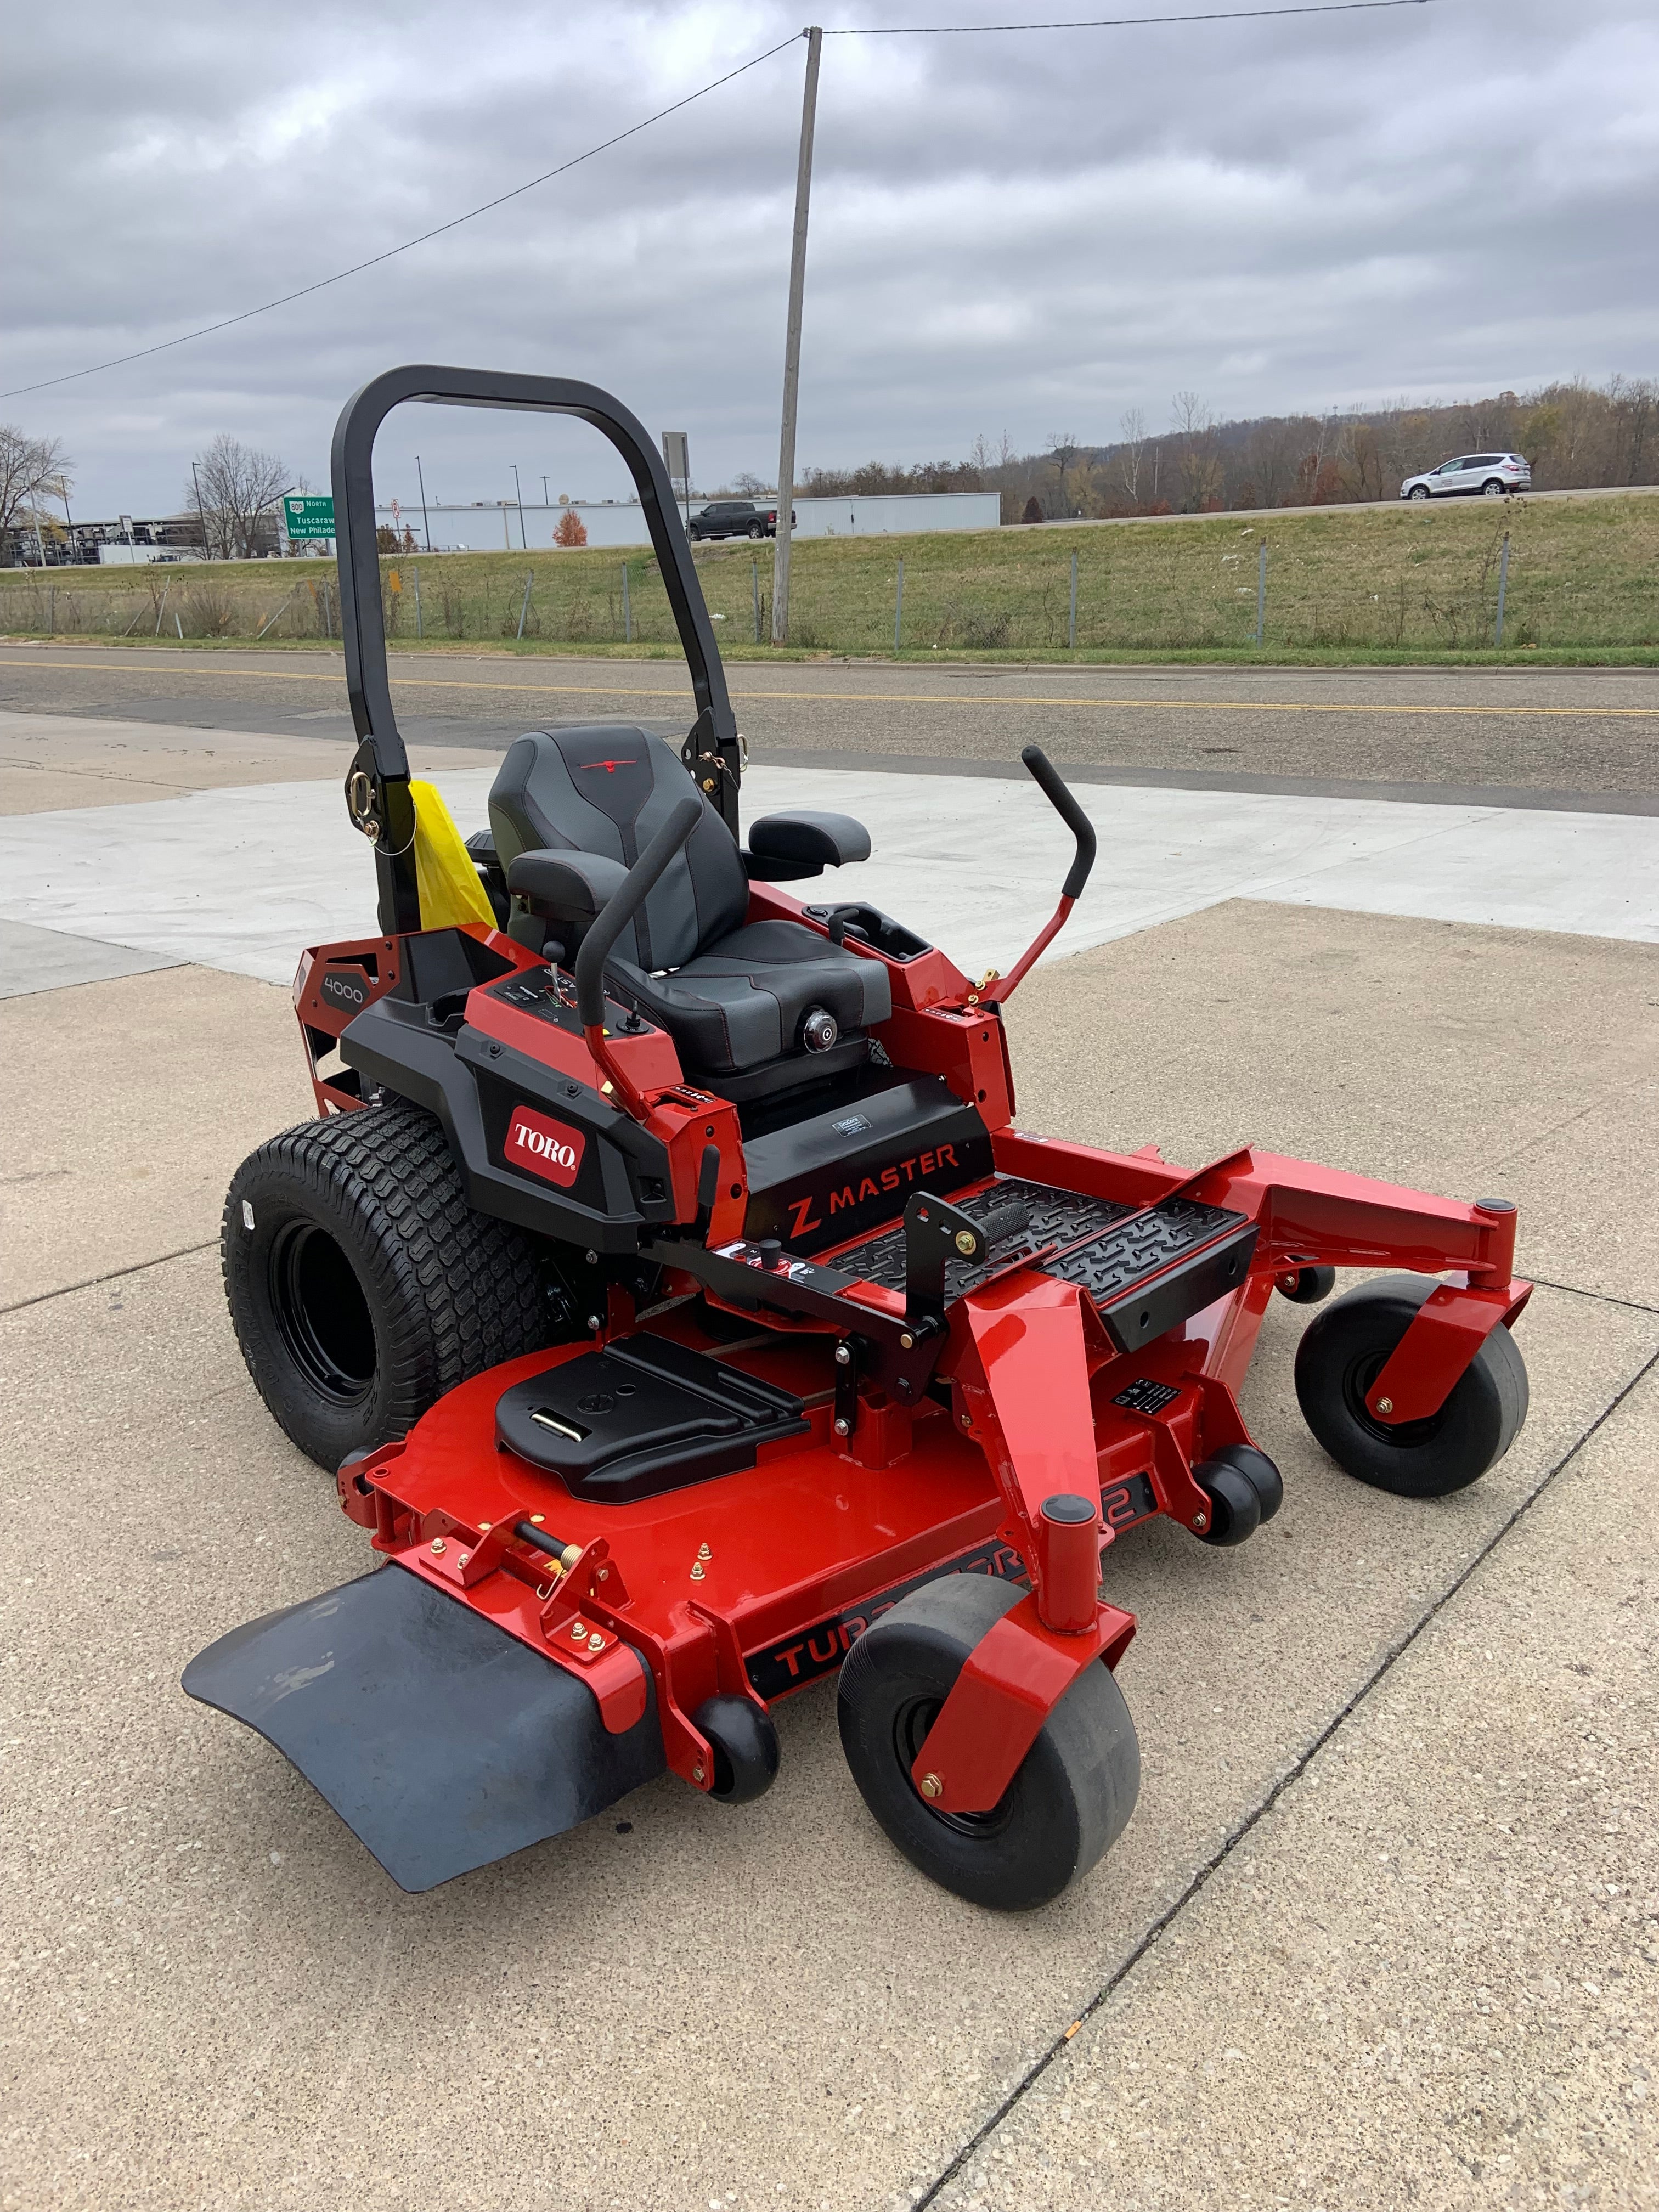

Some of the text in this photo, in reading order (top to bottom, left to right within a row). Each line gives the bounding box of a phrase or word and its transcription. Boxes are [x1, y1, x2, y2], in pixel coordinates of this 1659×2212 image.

[325, 978, 363, 1003] 4000
[543, 969, 576, 988] ASTR
[515, 1123, 575, 1167] TORO
[788, 1143, 960, 1239] Z MASTER
[1103, 1487, 1135, 1525] 2
[774, 1589, 916, 1677] TUR
